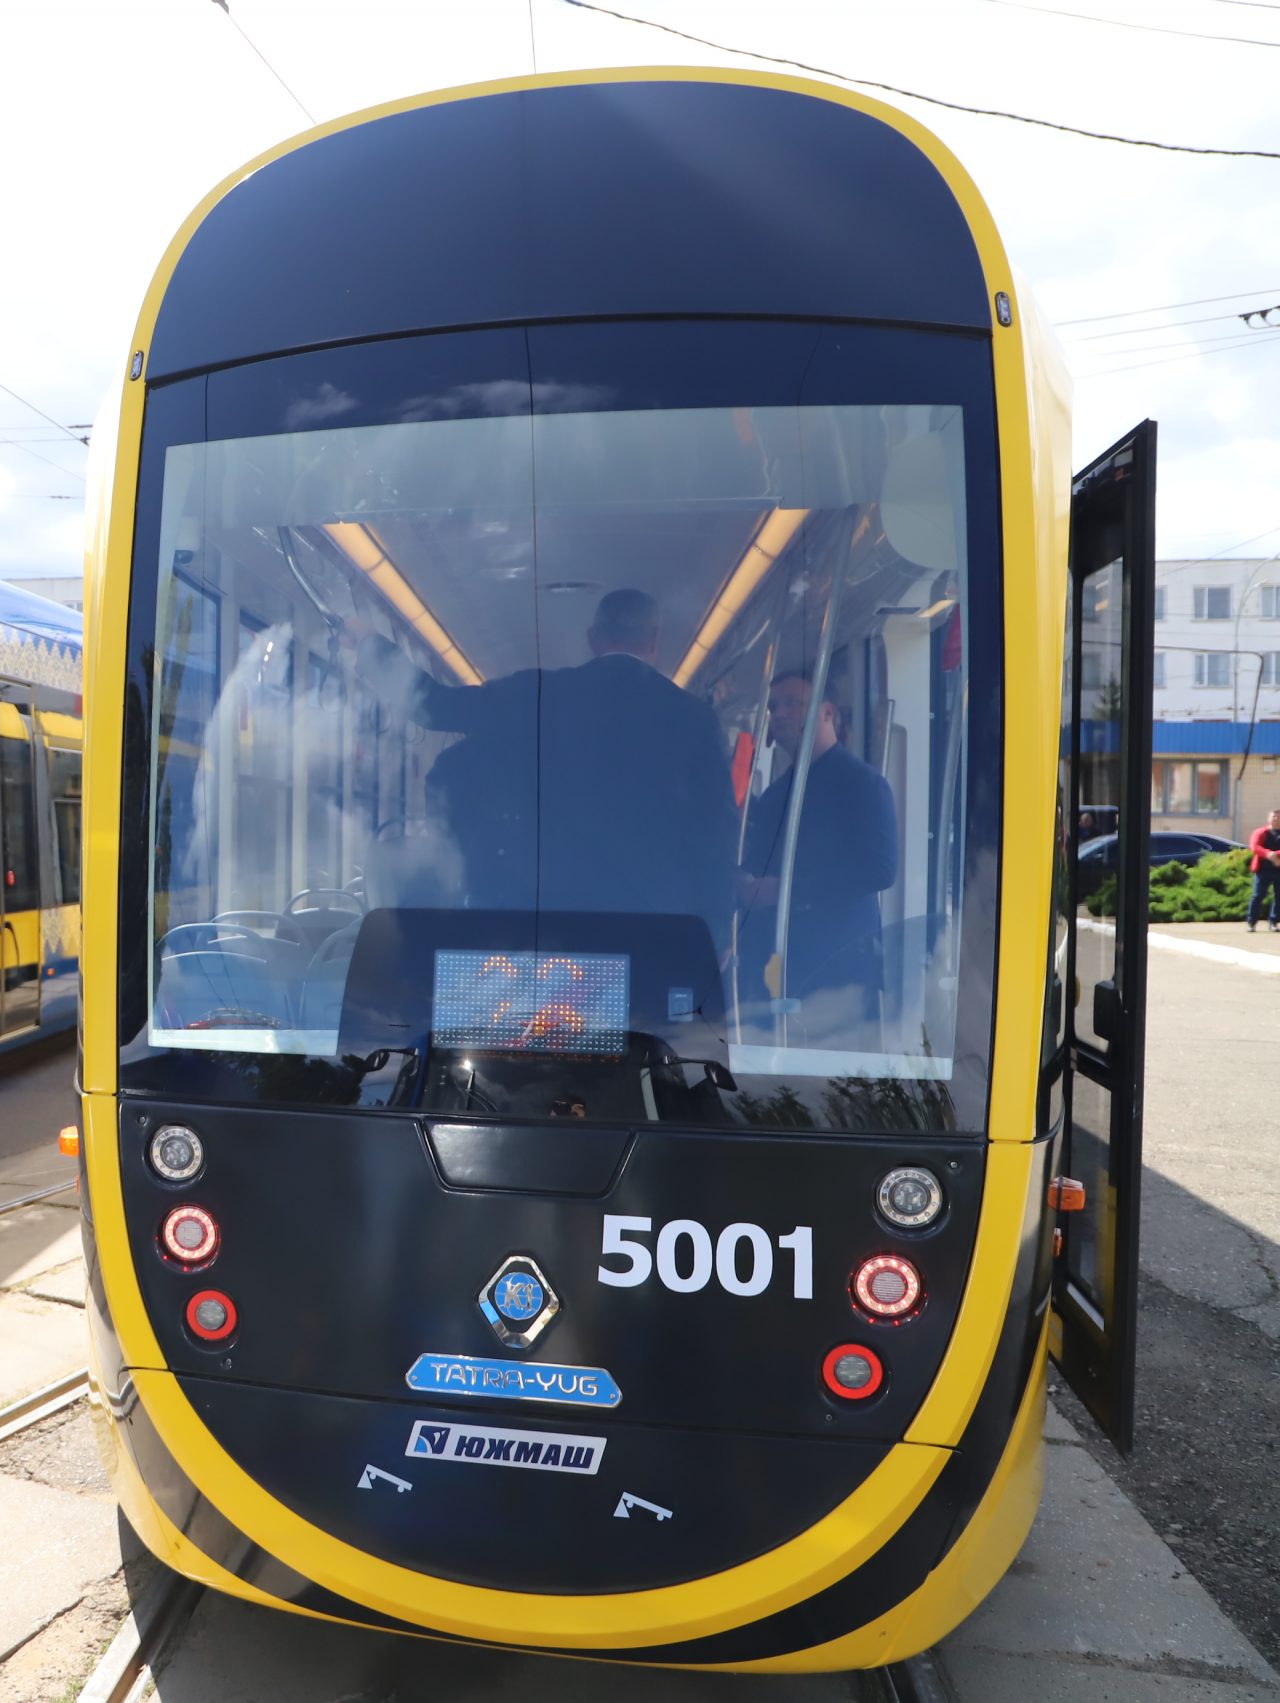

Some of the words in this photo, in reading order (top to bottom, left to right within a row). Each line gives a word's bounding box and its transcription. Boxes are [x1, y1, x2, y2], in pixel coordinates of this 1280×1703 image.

[597, 1214, 813, 1299] 5001
[431, 1362, 600, 1397] TATRA-YUG
[454, 1434, 595, 1469] ЮЖМАШ
